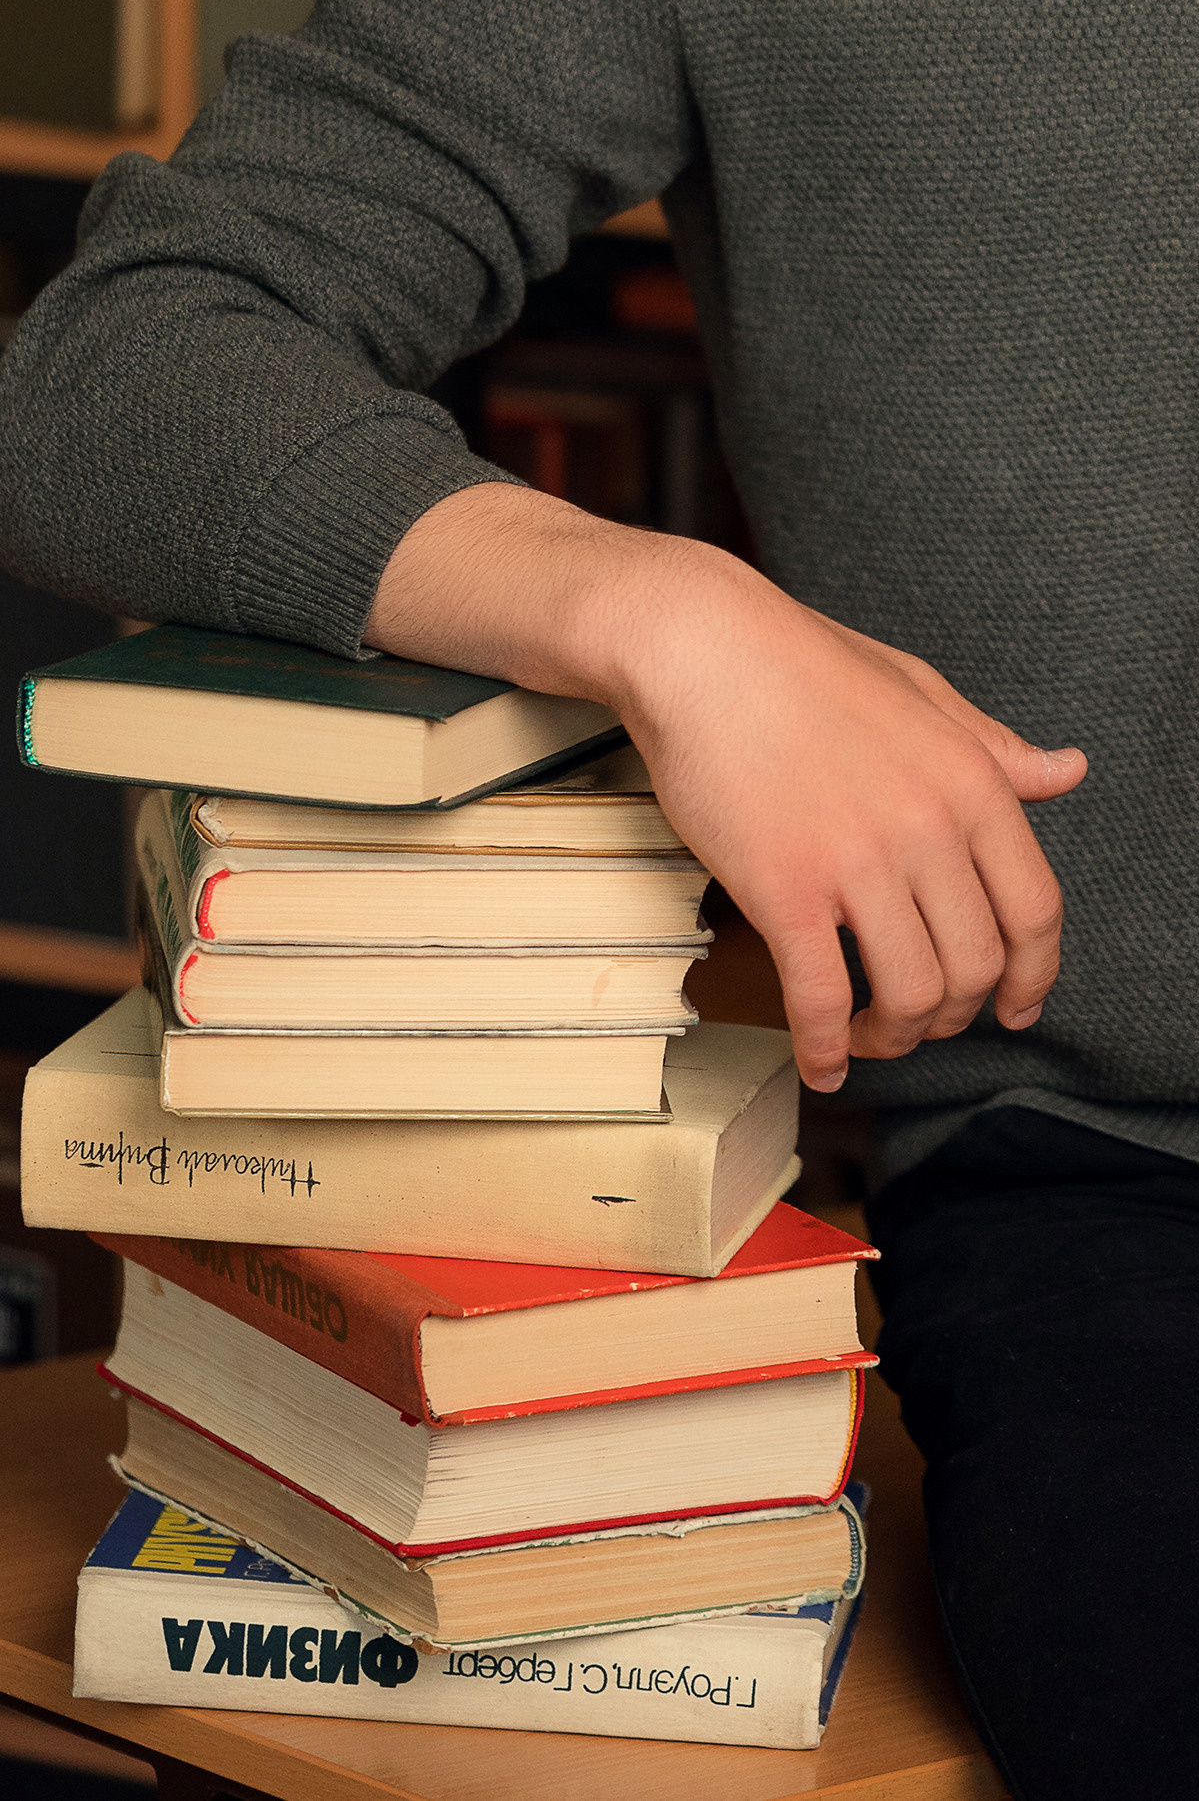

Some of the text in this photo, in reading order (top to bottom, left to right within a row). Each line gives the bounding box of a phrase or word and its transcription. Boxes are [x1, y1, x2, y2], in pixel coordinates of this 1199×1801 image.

[176, 1149, 321, 1199] Николай
[244, 1249, 349, 1343] ОБЩАЯ
[131, 1505, 240, 1575] PHYS
[161, 1616, 419, 1689] ФИЗИКА
